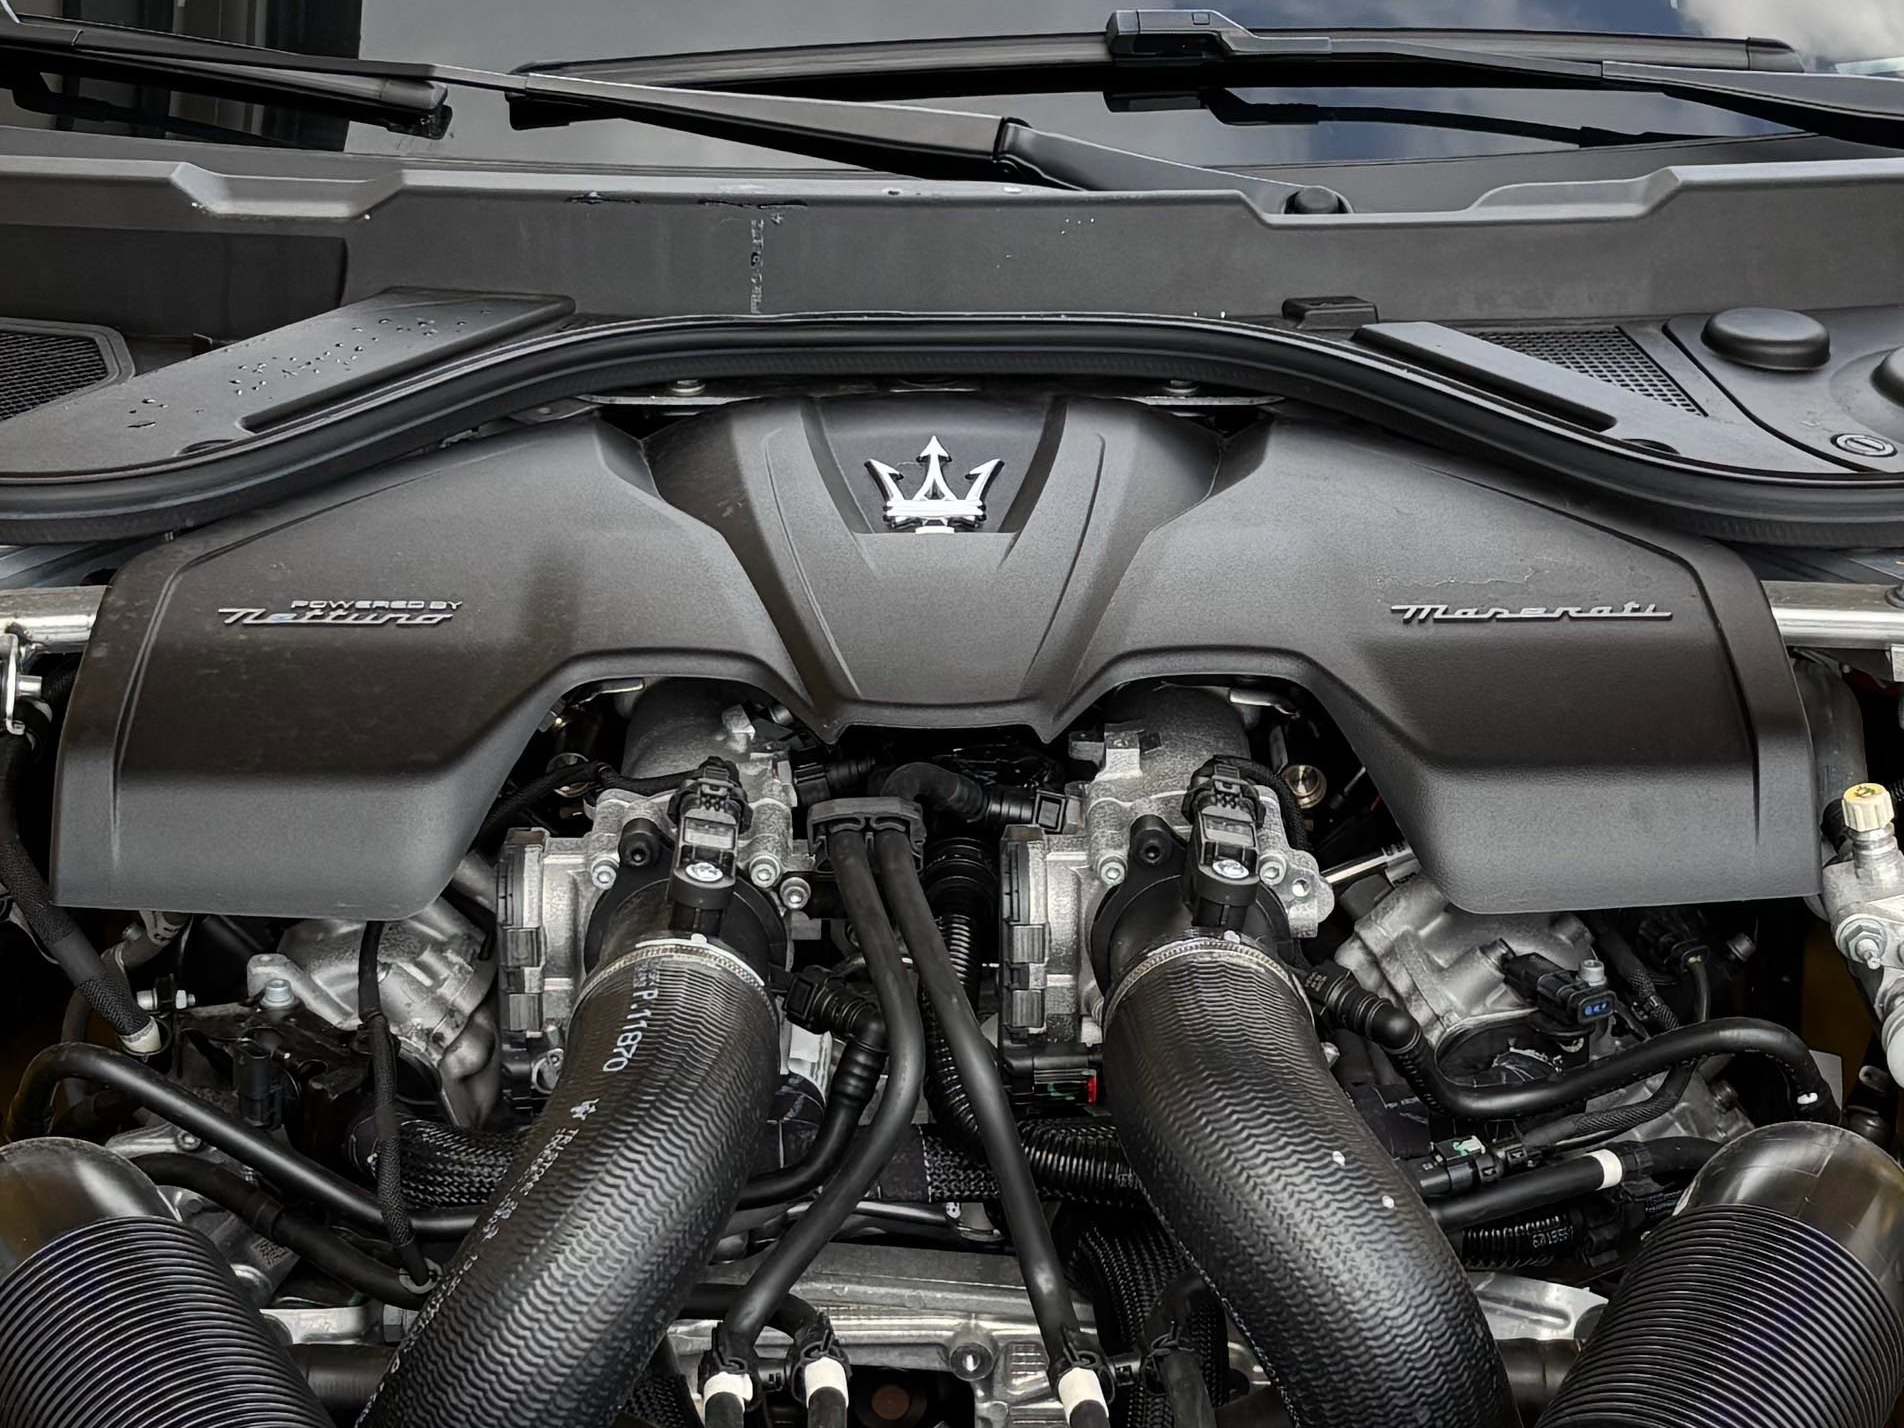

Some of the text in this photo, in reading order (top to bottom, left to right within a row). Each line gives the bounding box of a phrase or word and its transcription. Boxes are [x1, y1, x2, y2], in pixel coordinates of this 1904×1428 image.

[289, 599, 464, 610] POWERED BY
[1391, 600, 1673, 623] Maserati
[217, 607, 454, 627] Nettuno
